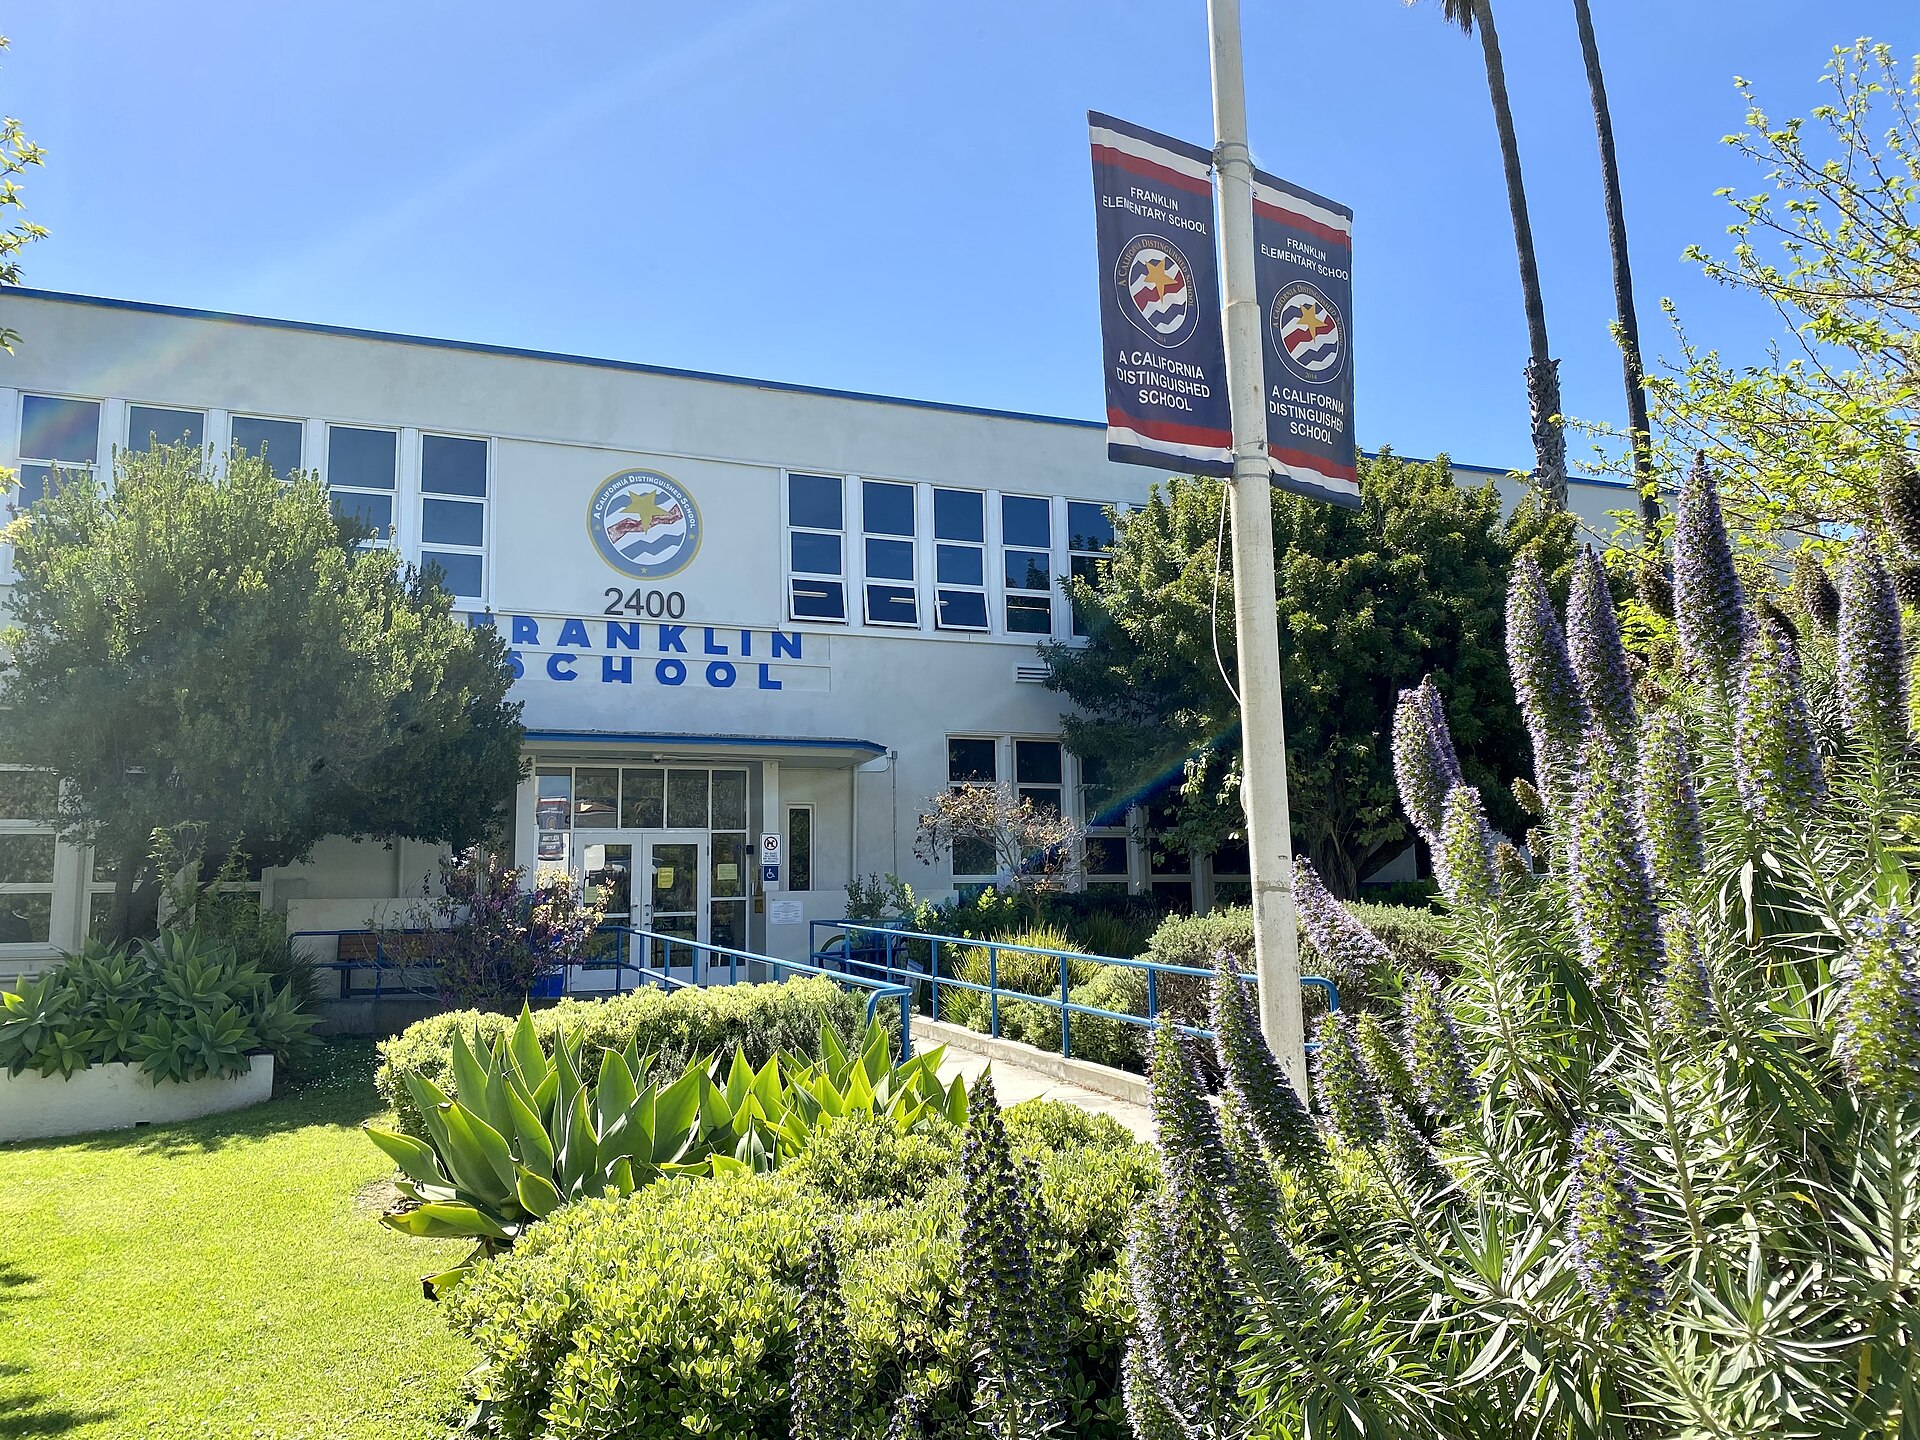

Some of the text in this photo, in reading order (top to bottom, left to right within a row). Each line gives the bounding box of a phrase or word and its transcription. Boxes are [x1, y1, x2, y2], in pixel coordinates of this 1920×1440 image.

[1102, 194, 1207, 235] ELEMENTARY SCHOOL
[1130, 186, 1179, 211] FRANKLIN
[1261, 243, 1348, 281] ELEMENTARY SCHOO
[1286, 237, 1326, 262] FRANKLIN
[1119, 350, 1205, 380] A CALIFORNIA
[1116, 366, 1210, 398] DISTINGUISHED
[1138, 389, 1193, 412] SCHOOL
[1272, 384, 1344, 416] A CALIFORNIA
[1269, 400, 1344, 433] DISTINGUISHED
[1290, 421, 1333, 445] SCHOOL
[595, 478, 629, 511] CALIFORNIA
[628, 475, 682, 499] DISTINGUISHED
[680, 497, 696, 529] SCHOOL
[604, 587, 686, 619] 2400
